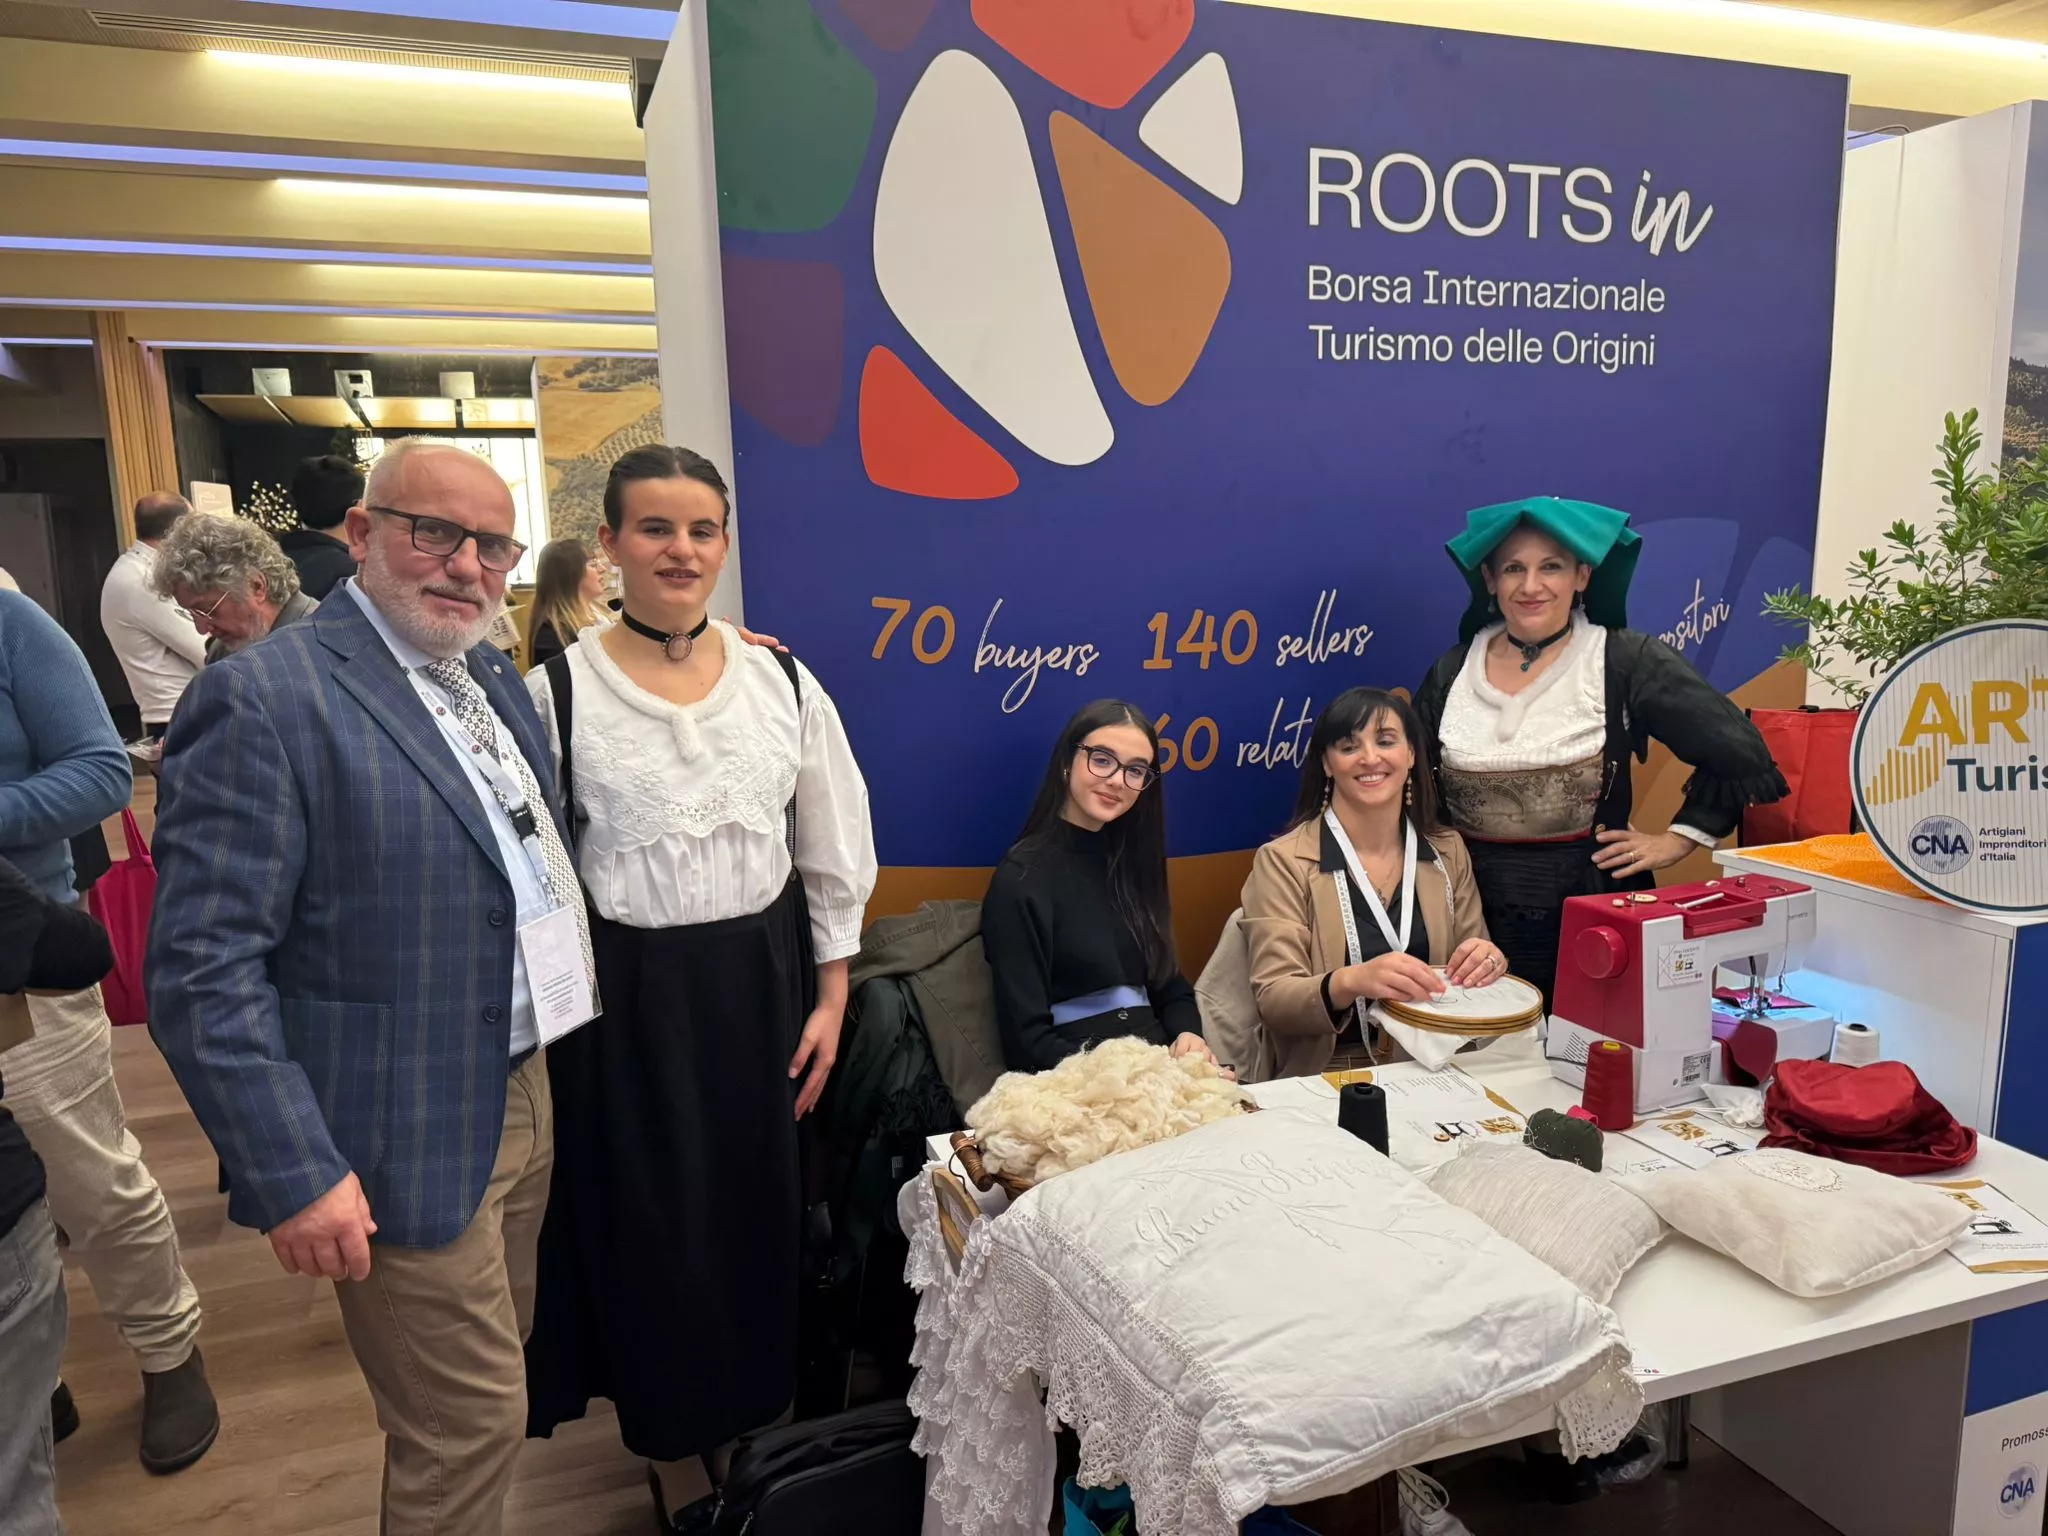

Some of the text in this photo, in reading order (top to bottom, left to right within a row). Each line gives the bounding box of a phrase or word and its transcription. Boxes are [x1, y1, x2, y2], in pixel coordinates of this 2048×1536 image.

[1308, 146, 1714, 256] ROOTS in
[1307, 264, 1666, 313] Borsa Internazionale
[1308, 324, 1656, 374] Turismo delle Origini
[1143, 589, 1374, 669] 140 sellers
[872, 597, 1100, 714] 70 buyers
[1237, 697, 1311, 769] relat
[1911, 834, 1969, 855] CNA
[1979, 826, 2026, 837] Artigiani
[1979, 839, 2047, 851] Imprenditori
[1980, 852, 2016, 862] d'Italia
[2000, 1477, 2035, 1504] CNA
